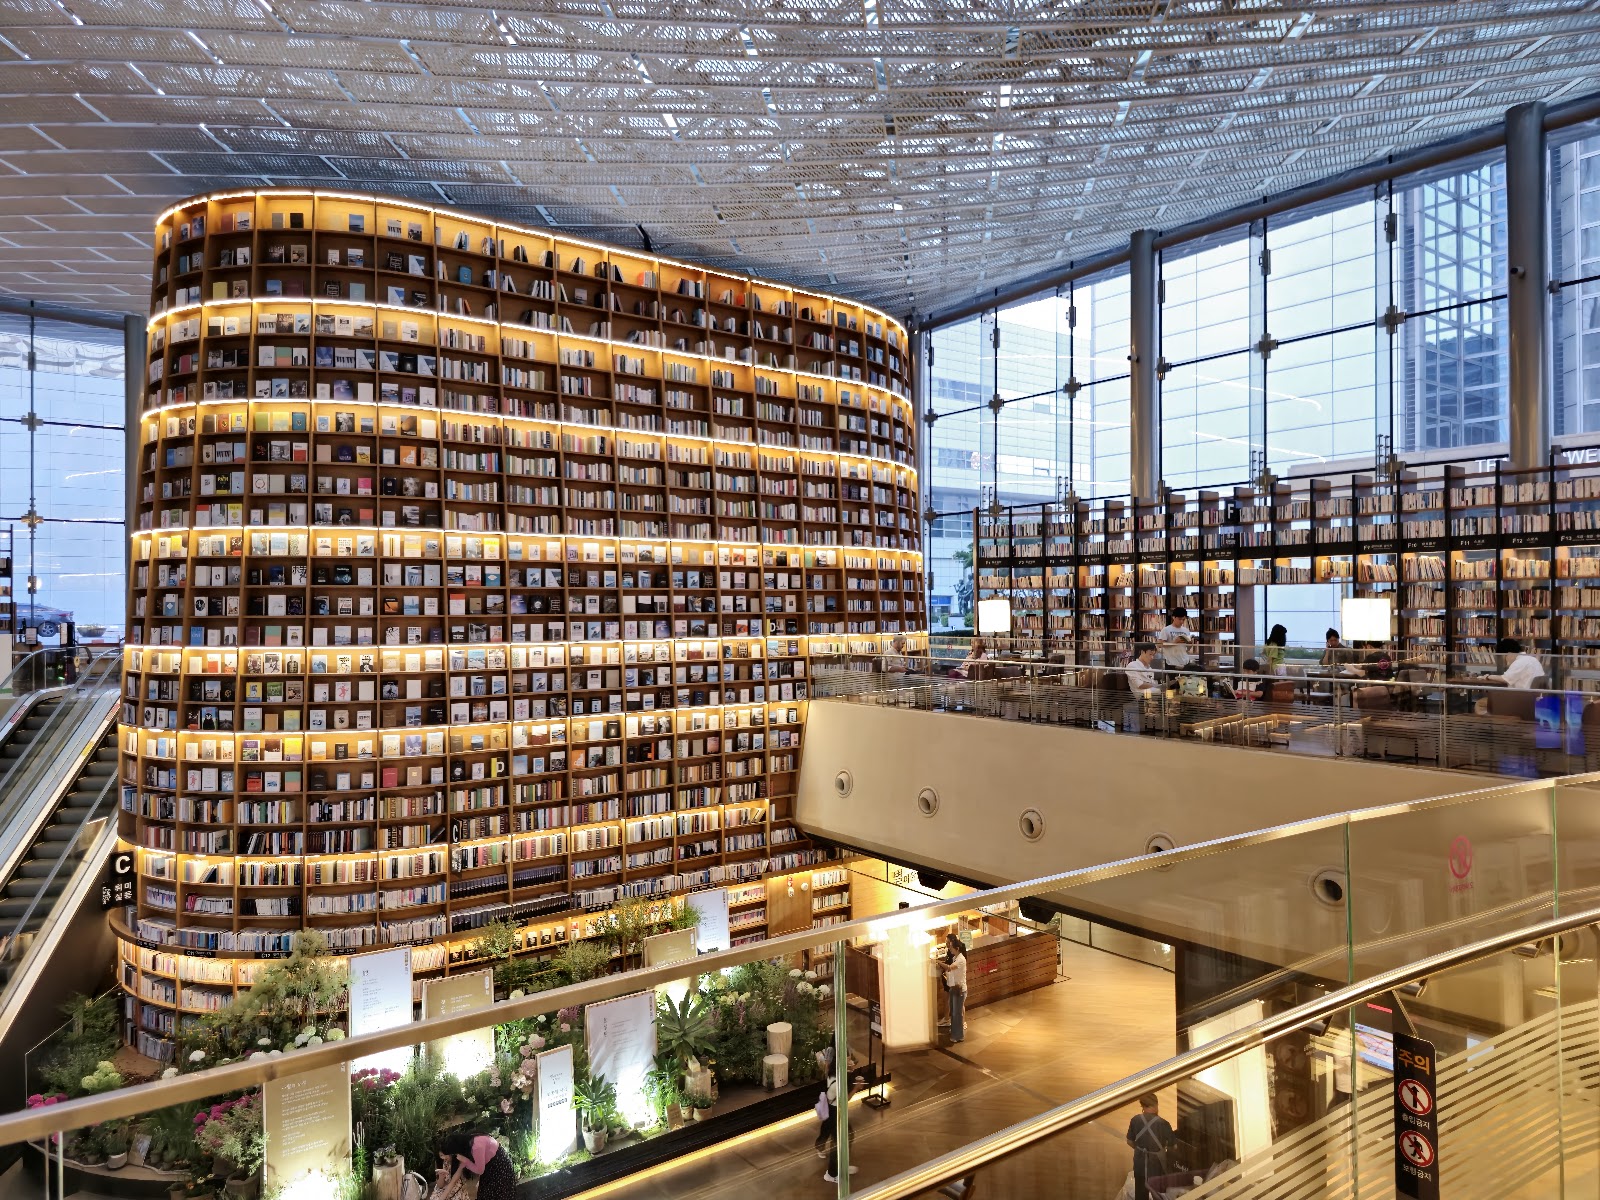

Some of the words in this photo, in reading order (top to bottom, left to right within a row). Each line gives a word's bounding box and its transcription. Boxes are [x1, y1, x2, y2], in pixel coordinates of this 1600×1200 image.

[1227, 503, 1235, 520] F
[115, 855, 131, 874] C
[1398, 1048, 1431, 1076] 주의
[1401, 1113, 1431, 1130] 출입금지
[1402, 1163, 1432, 1182] 보행금지
